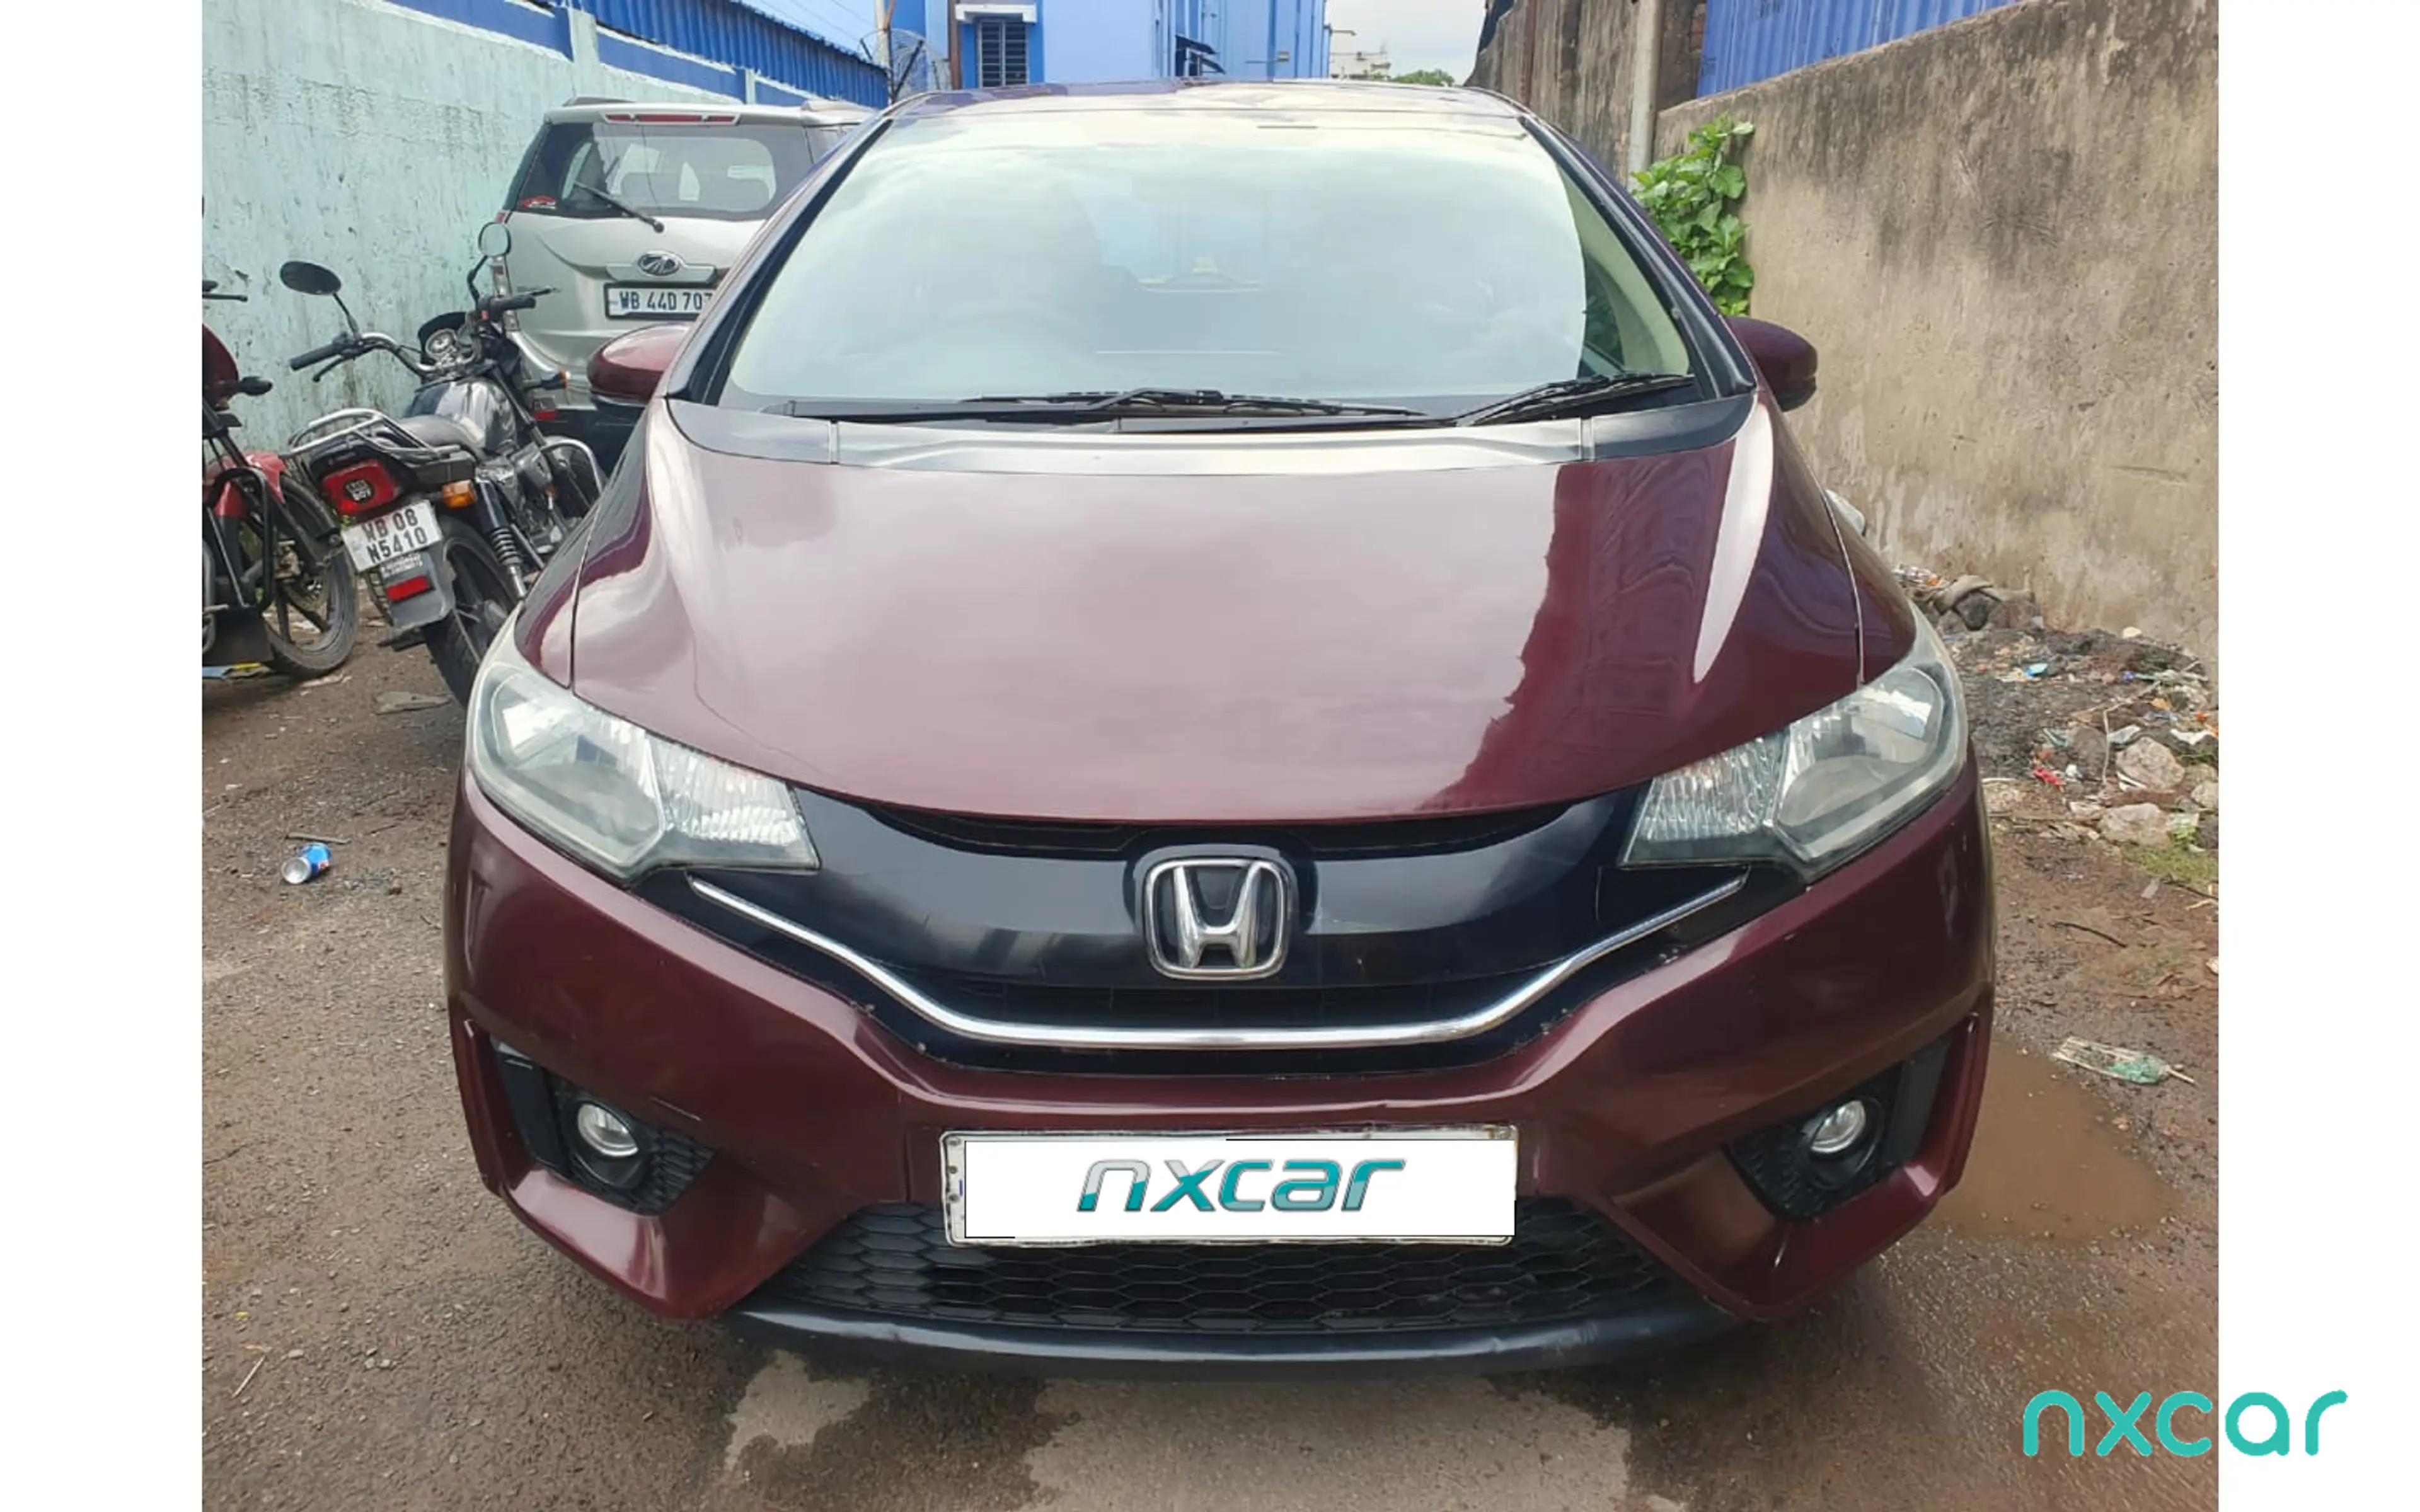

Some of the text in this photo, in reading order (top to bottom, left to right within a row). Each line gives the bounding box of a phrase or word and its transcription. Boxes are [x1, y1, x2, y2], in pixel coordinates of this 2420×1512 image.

[619, 290, 640, 309] WB
[647, 291, 677, 310] 44D
[360, 508, 418, 543] WB 08
